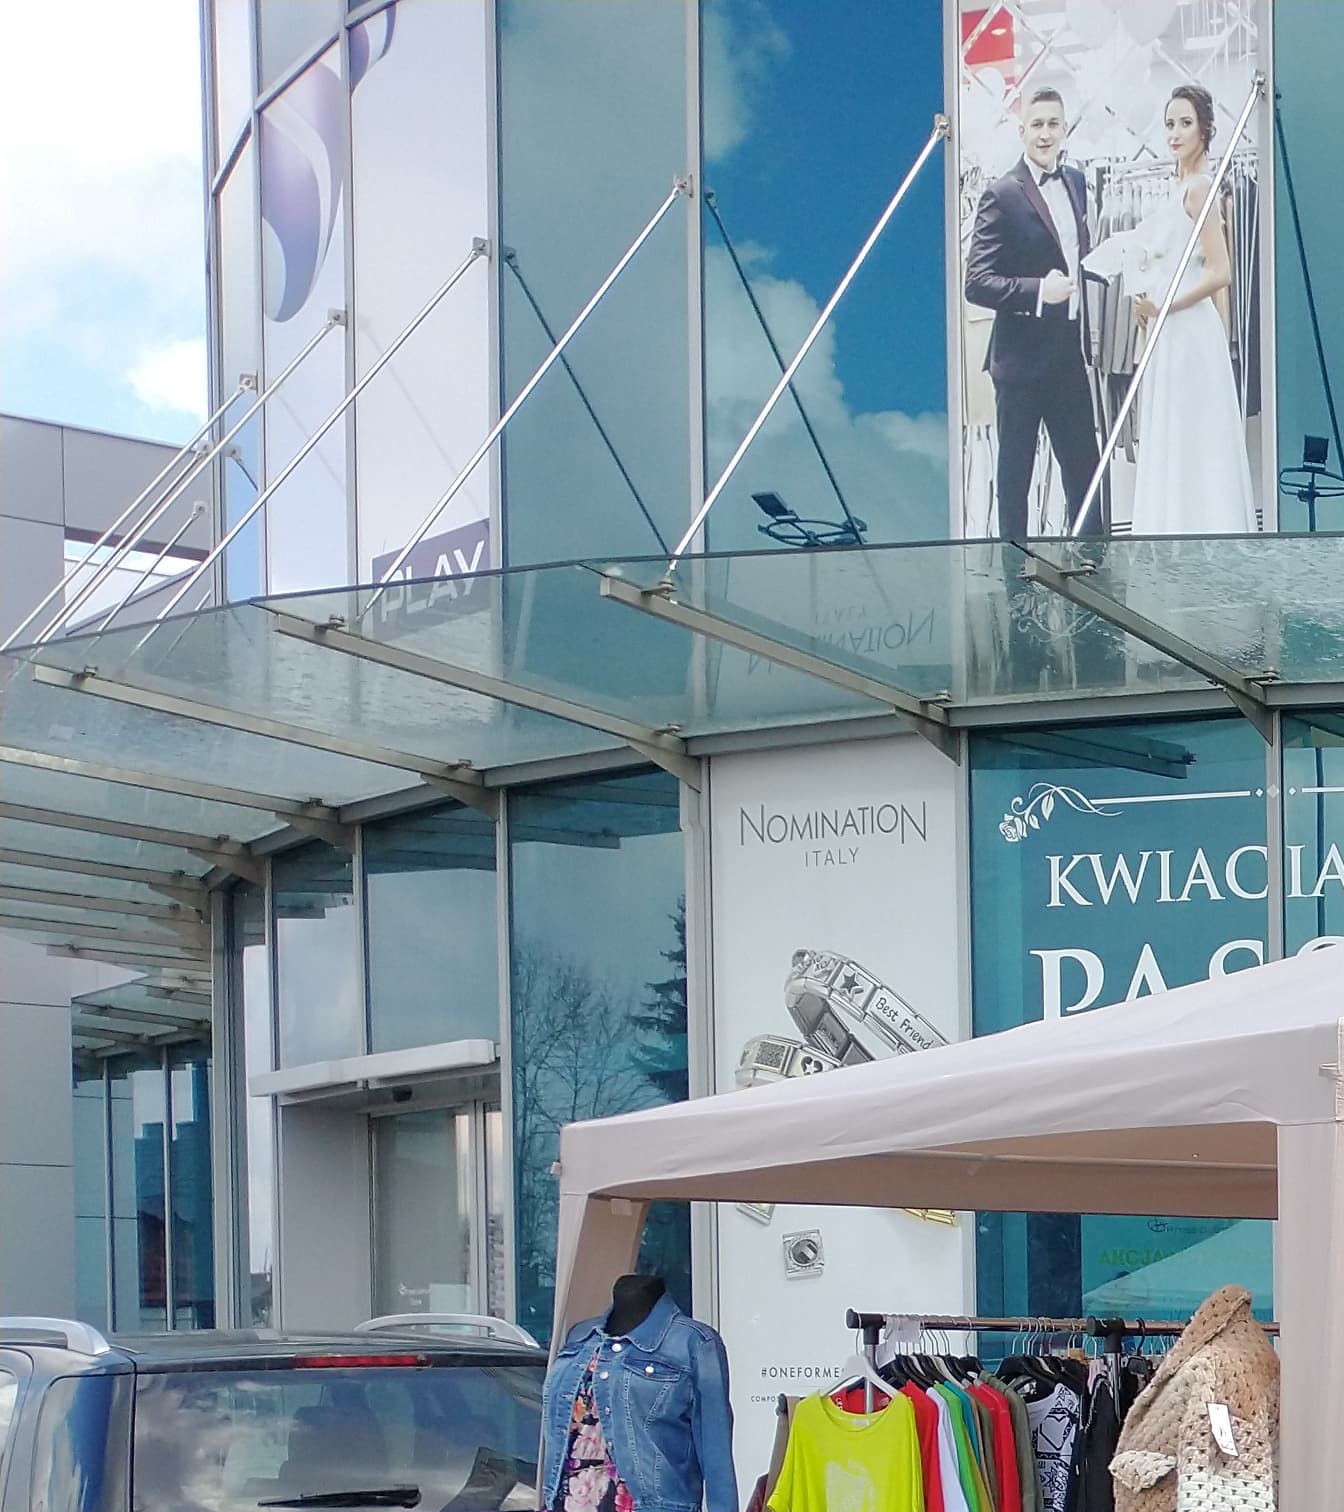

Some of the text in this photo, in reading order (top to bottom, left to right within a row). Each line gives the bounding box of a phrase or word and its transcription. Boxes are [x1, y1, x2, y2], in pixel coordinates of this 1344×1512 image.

[380, 540, 485, 623] PLAY
[804, 847, 860, 868] ITALY
[874, 996, 899, 1023] Best
[761, 1366, 845, 1379] #ONEFORME
[750, 1394, 777, 1403] COMPO
